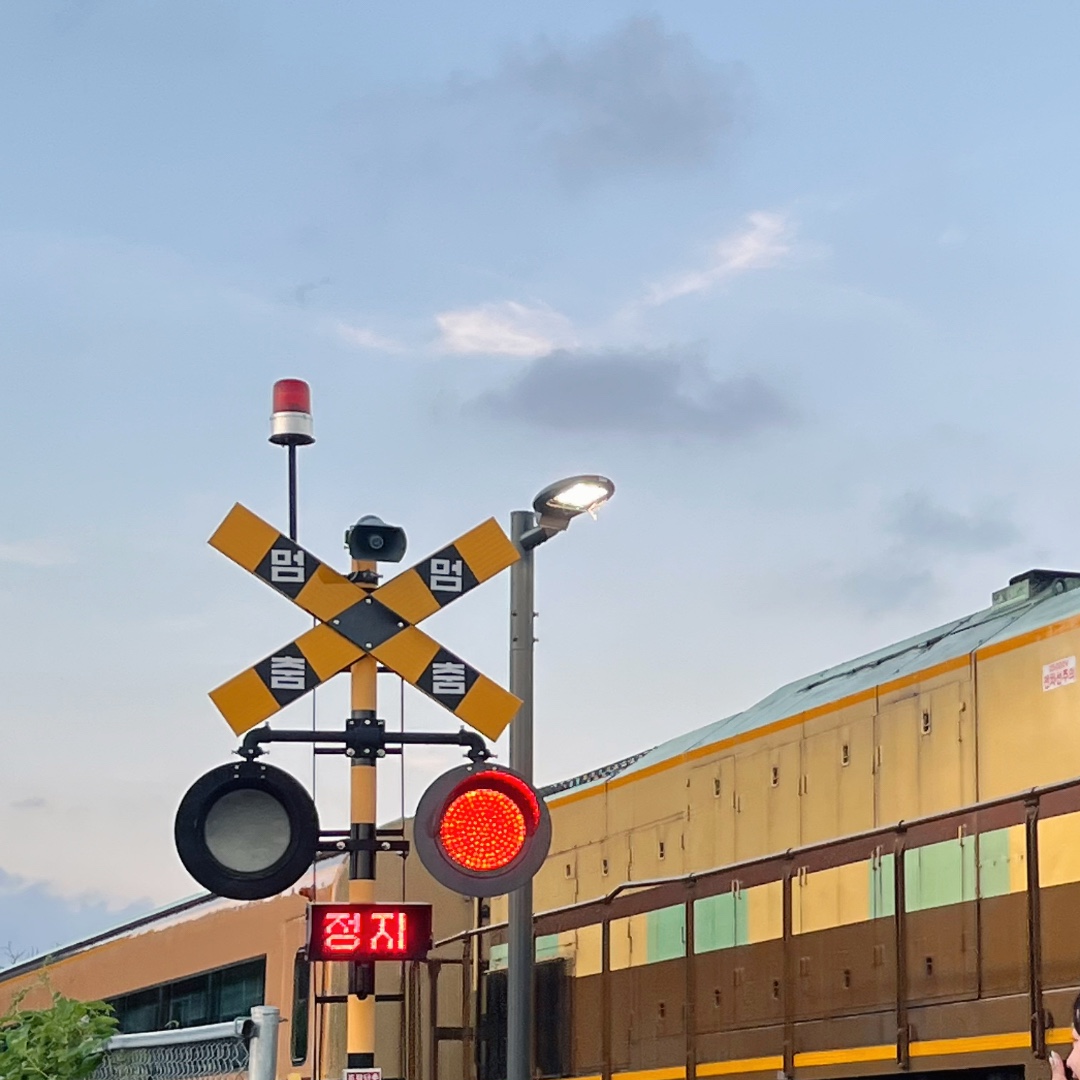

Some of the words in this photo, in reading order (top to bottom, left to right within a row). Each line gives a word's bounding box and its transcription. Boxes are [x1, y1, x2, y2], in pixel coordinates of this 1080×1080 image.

[270, 548, 305, 584] 멈
[430, 557, 463, 593] 멈
[270, 655, 306, 690] 춤
[432, 660, 466, 694] 춤
[323, 912, 407, 950] 정지
